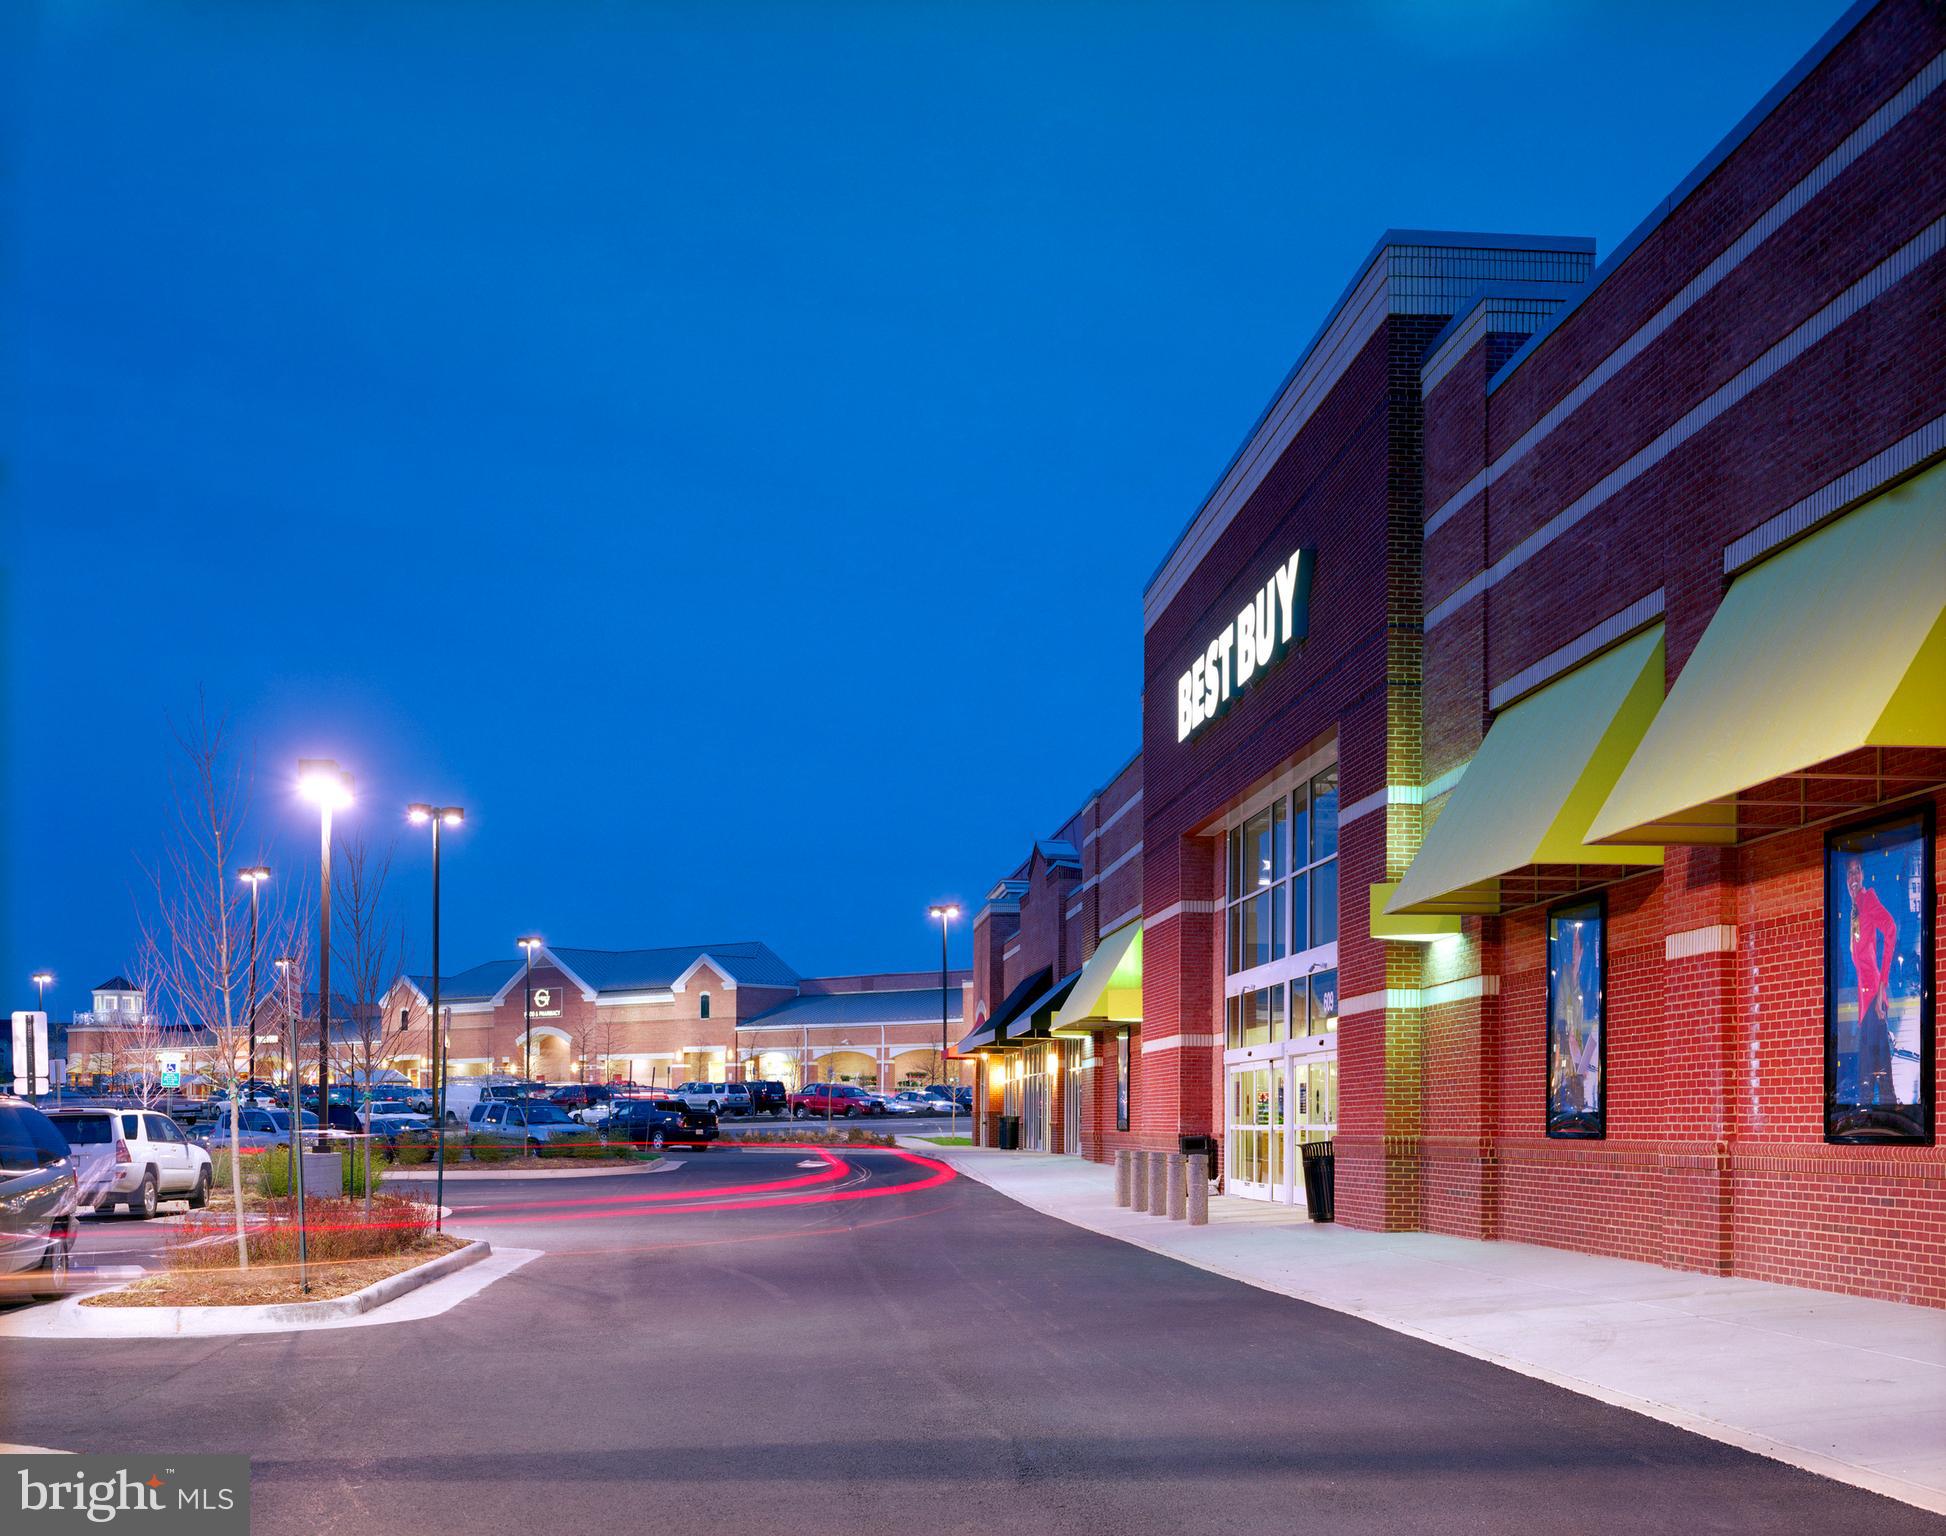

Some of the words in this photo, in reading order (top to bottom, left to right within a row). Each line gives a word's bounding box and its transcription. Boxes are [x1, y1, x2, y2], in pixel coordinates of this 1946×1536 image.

[1177, 622, 1234, 744] BEST
[1237, 548, 1301, 688] BUY
[1323, 991, 1334, 1012] 609
